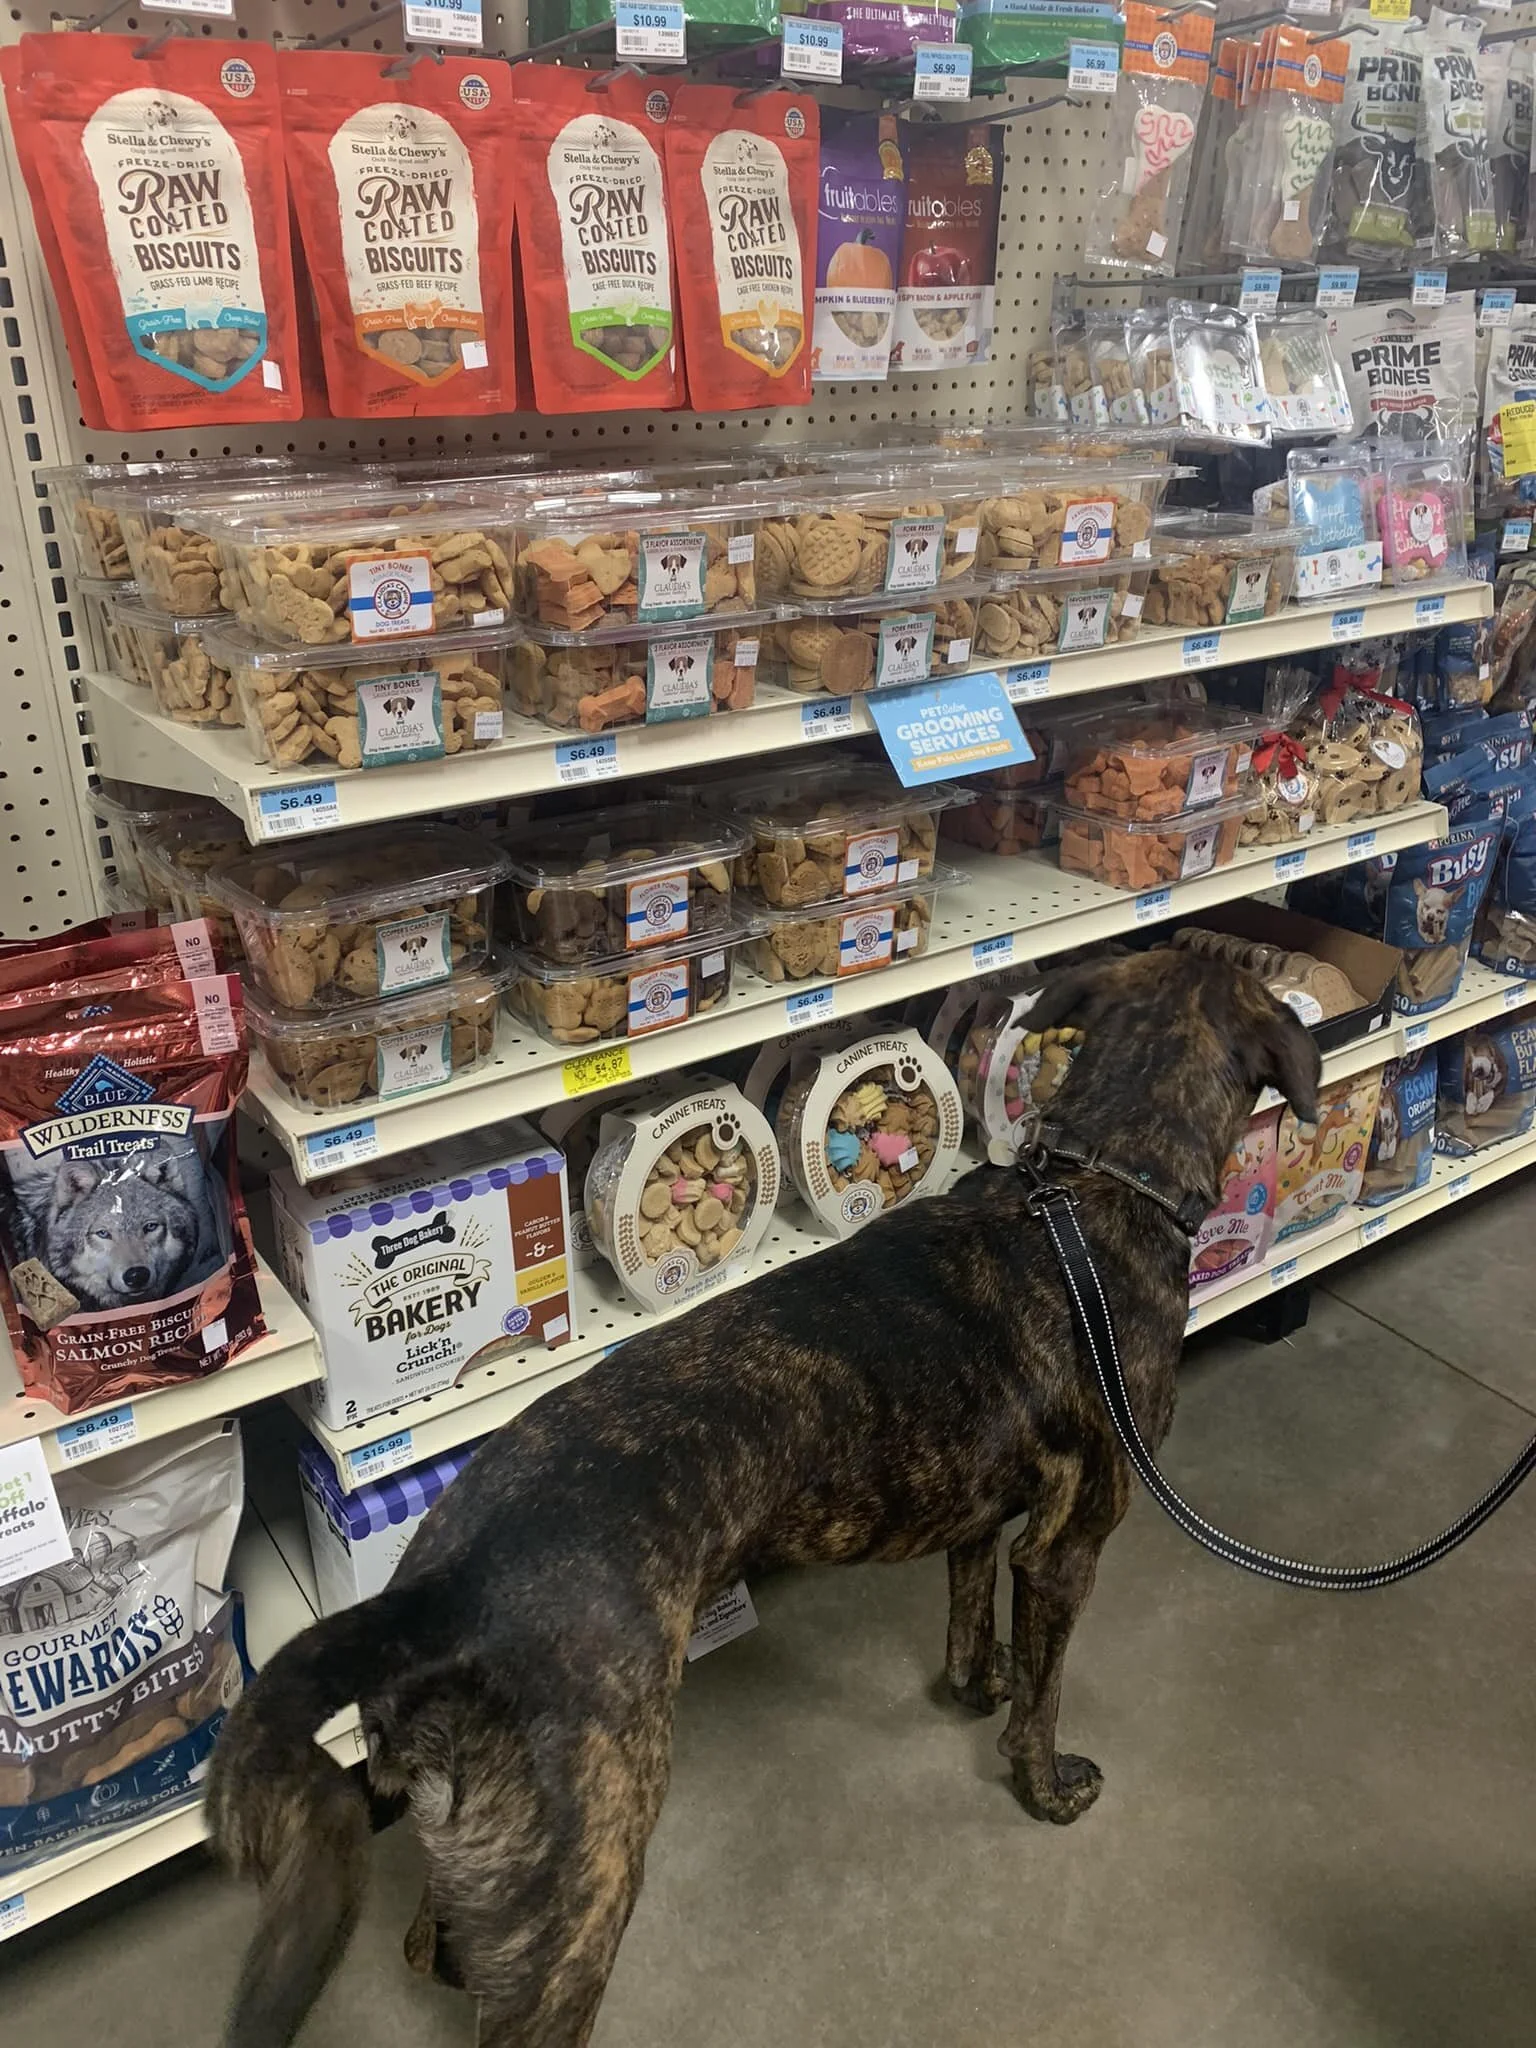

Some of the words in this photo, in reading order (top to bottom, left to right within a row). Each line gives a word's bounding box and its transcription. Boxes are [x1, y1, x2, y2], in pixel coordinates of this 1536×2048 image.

[846, 7, 862, 20] THE
[864, 8, 900, 20] ULTIMATE
[1010, 3, 1023, 11] Hand
[1026, 4, 1045, 12] Made
[1074, 5, 1094, 13] Baked
[633, 14, 667, 28] $10.99
[799, 33, 829, 47] $10.99
[933, 63, 956, 73] $6.99
[1086, 59, 1106, 69] $6.99
[1433, 55, 1476, 80] PRIM
[225, 73, 251, 83] USA
[463, 88, 487, 97] USA
[648, 103, 667, 111] USA
[787, 118, 803, 127] USA
[107, 133, 146, 146] Stella
[147, 134, 158, 146] &
[159, 133, 212, 148] Chewy's
[351, 144, 386, 155] Stella
[389, 145, 398, 155] &
[398, 146, 446, 159] Chewy's
[564, 153, 590, 163] Stella
[600, 154, 640, 166] Chewy's
[118, 158, 216, 169] FREEZE-DRIED
[360, 167, 449, 179] FREEZE-DRIED
[713, 166, 737, 176] Stella
[747, 167, 774, 178] Chewy's
[569, 174, 642, 185] FREEZE-DRIED
[118, 168, 221, 220] RAW
[355, 176, 452, 224] RAW
[718, 186, 776, 195] FREEZE-DRIED
[824, 183, 897, 213] fruitables
[569, 184, 645, 230] RAW
[718, 195, 780, 236] RAW
[130, 202, 228, 239] COATED
[364, 210, 455, 243] COATED
[578, 215, 648, 246] COATED
[727, 223, 786, 252] COATED
[133, 241, 241, 272] BISCUITS
[365, 246, 462, 274] BISCUITS
[581, 249, 656, 275] BISCUITS
[731, 255, 792, 280] BISCUITS
[151, 277, 190, 290] GRASS-FED
[193, 276, 213, 287] LAMB
[215, 276, 240, 290] RECIPE
[377, 280, 414, 292] GRASS-FED
[416, 279, 432, 289] BEEF
[435, 280, 458, 291] RECIPE
[592, 280, 620, 292] CAGE-FREE
[622, 280, 636, 289] DUCK
[638, 280, 655, 292] RECIPE
[815, 295, 844, 305] MPKIN
[852, 295, 886, 305] BLUEBERRY
[916, 293, 935, 301] BACON
[943, 293, 965, 301] APPLE
[1351, 341, 1441, 372] PRIME
[1508, 343, 1536, 368] PRIM
[1367, 367, 1430, 387] BONES
[650, 540, 668, 549] FLAVOR
[669, 538, 703, 547] ASSORTMENT
[369, 564, 385, 575] TINY
[388, 562, 413, 573] BONES
[892, 625, 906, 633] FORK
[907, 622, 923, 630] PRESS
[677, 640, 709, 650] ASSORTMENT
[1191, 639, 1212, 650] $6.49
[1016, 669, 1041, 681] $6.49
[374, 683, 391, 692] TINY
[394, 679, 420, 690] BONES
[813, 705, 842, 719] $6.49
[378, 723, 424, 738] CLAUDIA'S
[896, 707, 1004, 740] GROOMING
[909, 724, 1000, 755] SERVICES
[570, 746, 605, 760] $6.49
[280, 794, 322, 810] $6.49
[1431, 837, 1492, 885] Busy
[1143, 894, 1164, 906] $6.49
[185, 937, 201, 947] NO
[982, 939, 1006, 953] $6.49
[204, 994, 220, 1004] NO
[797, 993, 824, 1008] $6.49
[564, 1048, 625, 1071] CLEARANCE
[595, 1057, 623, 1074] $4.87
[836, 1043, 873, 1073] CANINE
[873, 1040, 908, 1053] TREATS
[44, 1067, 80, 1079] Healthy
[123, 1055, 157, 1068] Holistic
[84, 1090, 128, 1107] BLUE
[30, 1109, 185, 1147] WILDERNESS
[652, 1107, 690, 1140] CANINE
[690, 1098, 726, 1114] TREATS
[67, 1137, 105, 1159] Trail
[106, 1137, 155, 1155] Treats
[324, 1129, 362, 1148] $6.49
[1293, 1180, 1324, 1204] Treat
[1324, 1173, 1346, 1189] Me
[514, 1225, 539, 1237] PEANUT
[539, 1217, 561, 1229] BUTTER
[524, 1216, 545, 1227] CAROB
[380, 1240, 403, 1256] Three
[403, 1235, 419, 1247] Dog
[419, 1224, 444, 1239] Bakery
[1193, 1224, 1224, 1247] Love
[1227, 1218, 1249, 1234] Me
[371, 1276, 399, 1297] THE
[402, 1258, 466, 1282] ORIGINAL
[365, 1281, 482, 1342] BAKERY
[56, 1324, 146, 1345] GRAIN-FREE
[404, 1328, 425, 1345] for
[424, 1321, 453, 1336] Dogs
[56, 1340, 143, 1362] SALMON
[149, 1324, 200, 1350] RECI
[406, 1338, 451, 1360] Lick'n
[100, 1359, 138, 1371] Crunchy
[139, 1353, 156, 1365] Dog
[199, 1357, 212, 1369] NET
[396, 1343, 456, 1373] Crunch!
[396, 1367, 434, 1384] SANDWICH
[435, 1355, 465, 1371] COOKIES
[345, 1400, 357, 1414] 2
[76, 1415, 118, 1436] $8.49
[347, 1413, 358, 1421] PK
[363, 1438, 403, 1460] $15.99
[0, 1476, 21, 1493] et
[24, 1471, 32, 1482] 1
[0, 1500, 45, 1525] ffalo
[4, 1608, 119, 1667] GOURMET
[4, 1620, 163, 1718] EWARDS
[0, 1700, 123, 1757] ANUTTY
[131, 1642, 204, 1705] BITES
[0, 1824, 90, 1857] EN-BAKED
[91, 1798, 148, 1827] TREATS
[151, 1784, 180, 1802] FOR
